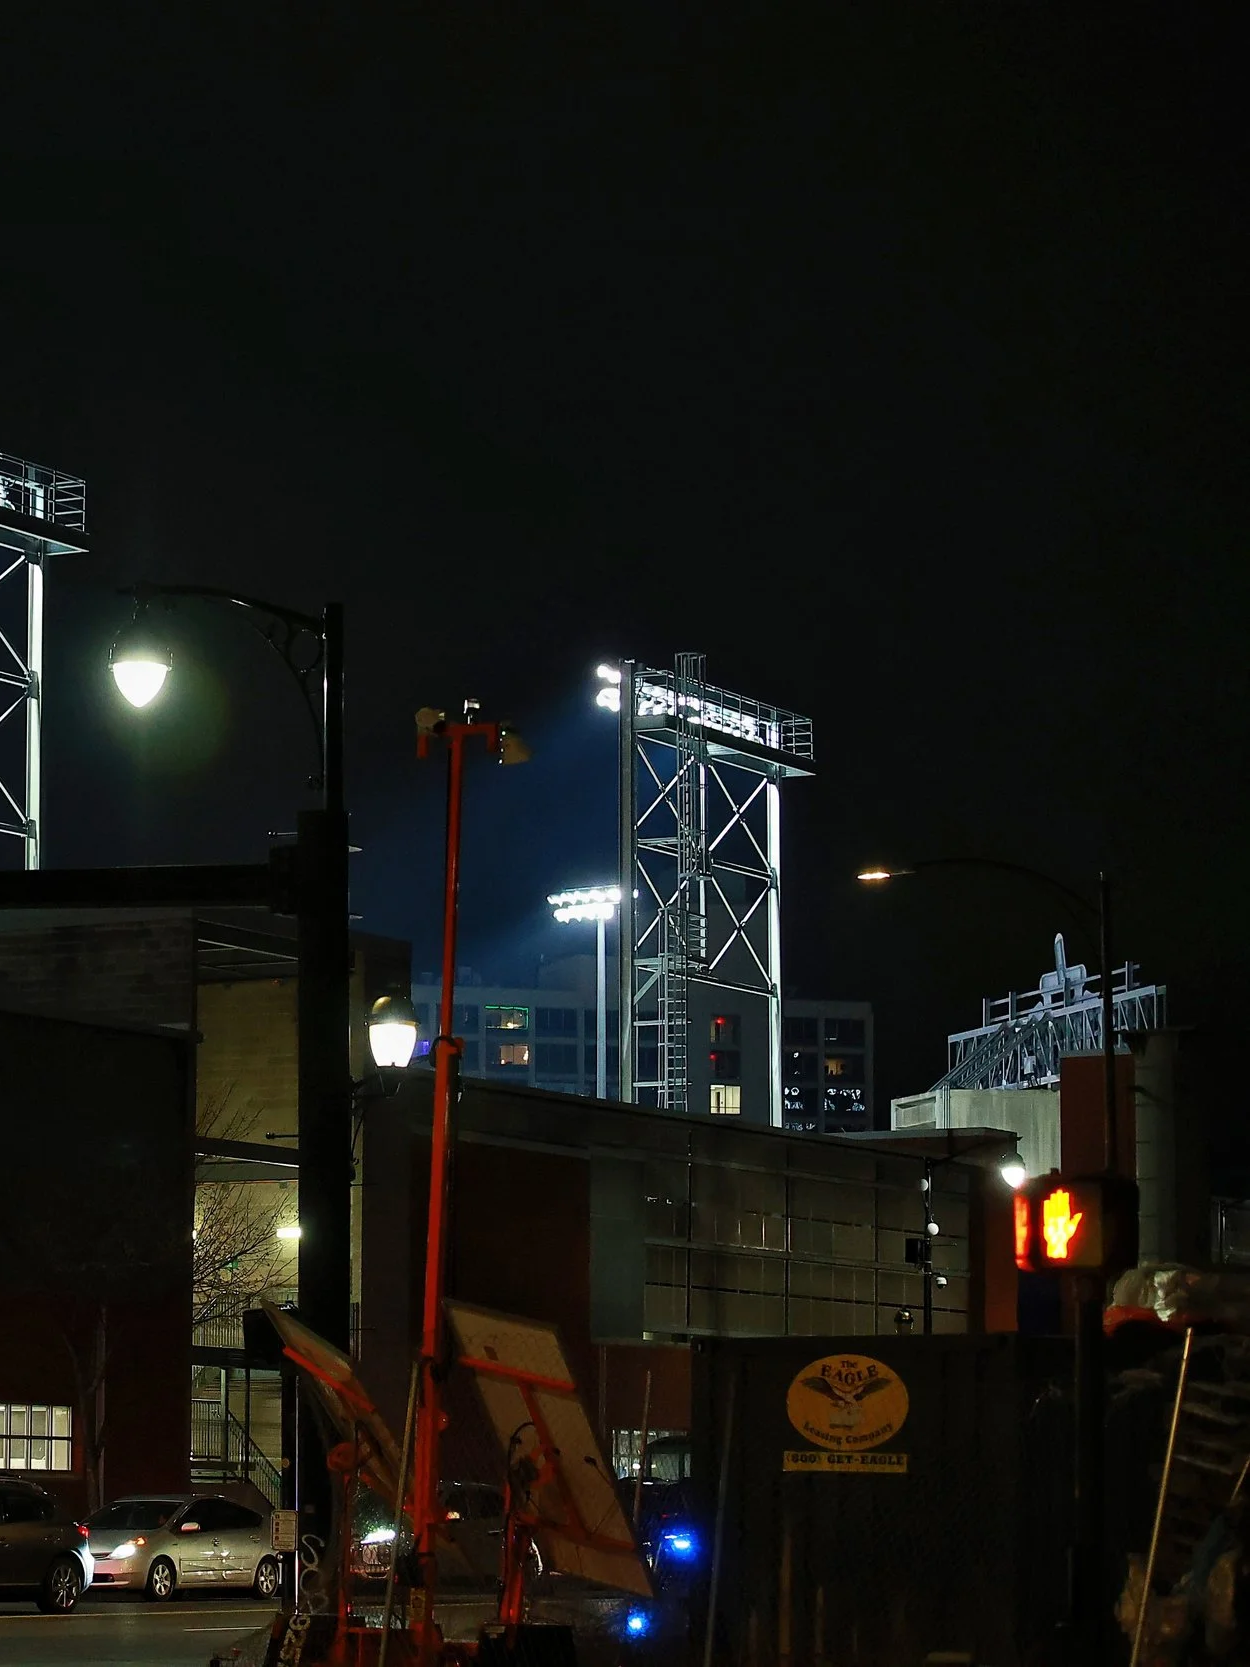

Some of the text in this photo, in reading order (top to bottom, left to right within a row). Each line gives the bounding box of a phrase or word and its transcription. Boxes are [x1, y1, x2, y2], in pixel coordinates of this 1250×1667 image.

[841, 1360, 858, 1369] The
[821, 1363, 879, 1387] EAGLE
[803, 1421, 893, 1445] Leasing Company
[827, 1454, 904, 1466] GET-EAGLE
